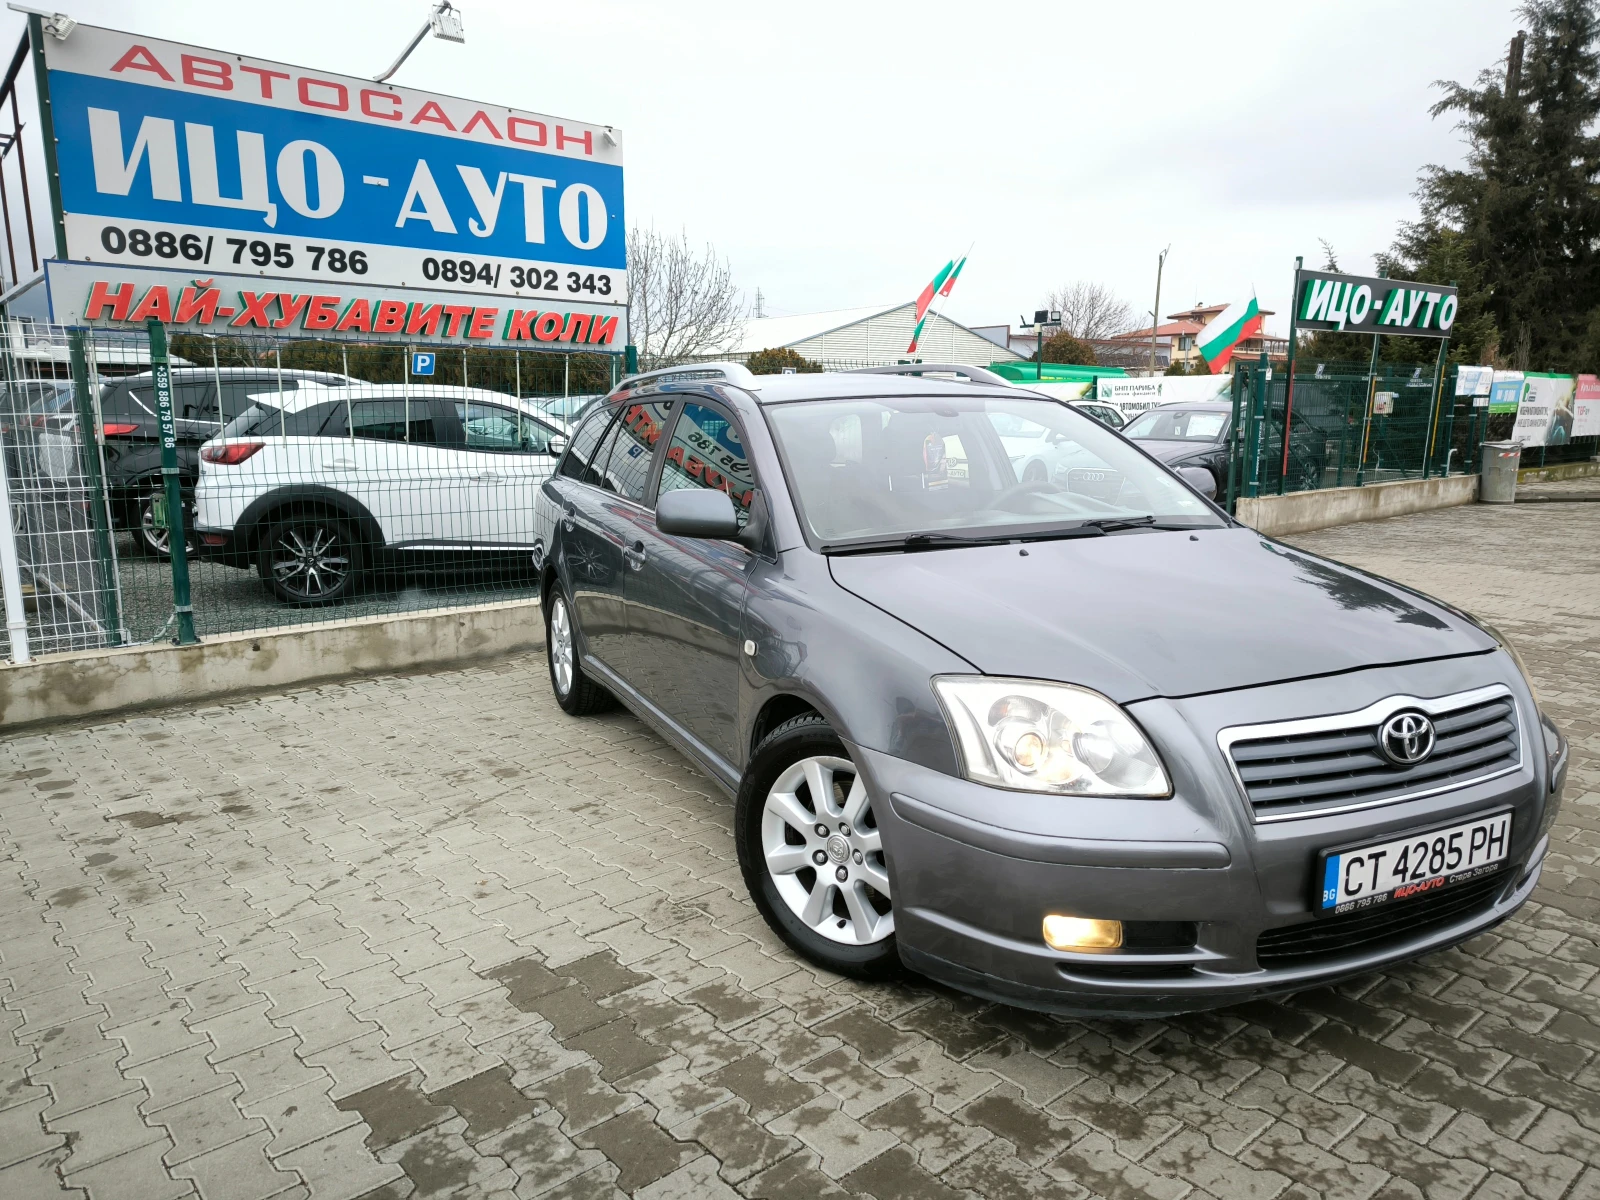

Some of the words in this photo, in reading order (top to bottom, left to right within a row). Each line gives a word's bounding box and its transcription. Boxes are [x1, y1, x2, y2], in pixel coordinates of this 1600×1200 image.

[110, 45, 593, 156] АВТОСАЛОН
[101, 226, 213, 265] 0886/
[226, 238, 294, 270] 795
[306, 246, 369, 276] 786
[422, 258, 502, 289] 0894/
[510, 265, 559, 291] 302
[567, 272, 612, 296] 343
[84, 279, 499, 339] НАЙ-ХУБАВИТЕ
[502, 309, 619, 345] КОЛИ
[417, 355, 431, 373] P
[156, 365, 168, 389] +359
[158, 391, 170, 408] 886
[160, 410, 172, 422] 79
[162, 425, 173, 435] 57
[164, 437, 175, 449] 86
[1392, 831, 1464, 884] 4285
[1322, 888, 1336, 902] BG
[1335, 902, 1355, 914] 0886
[1357, 897, 1373, 909] 795
[1373, 893, 1388, 904] 786
[1393, 876, 1445, 899] ИЦО-АУТО
[1449, 871, 1472, 883] Стара
[1473, 863, 1499, 877] Загора
